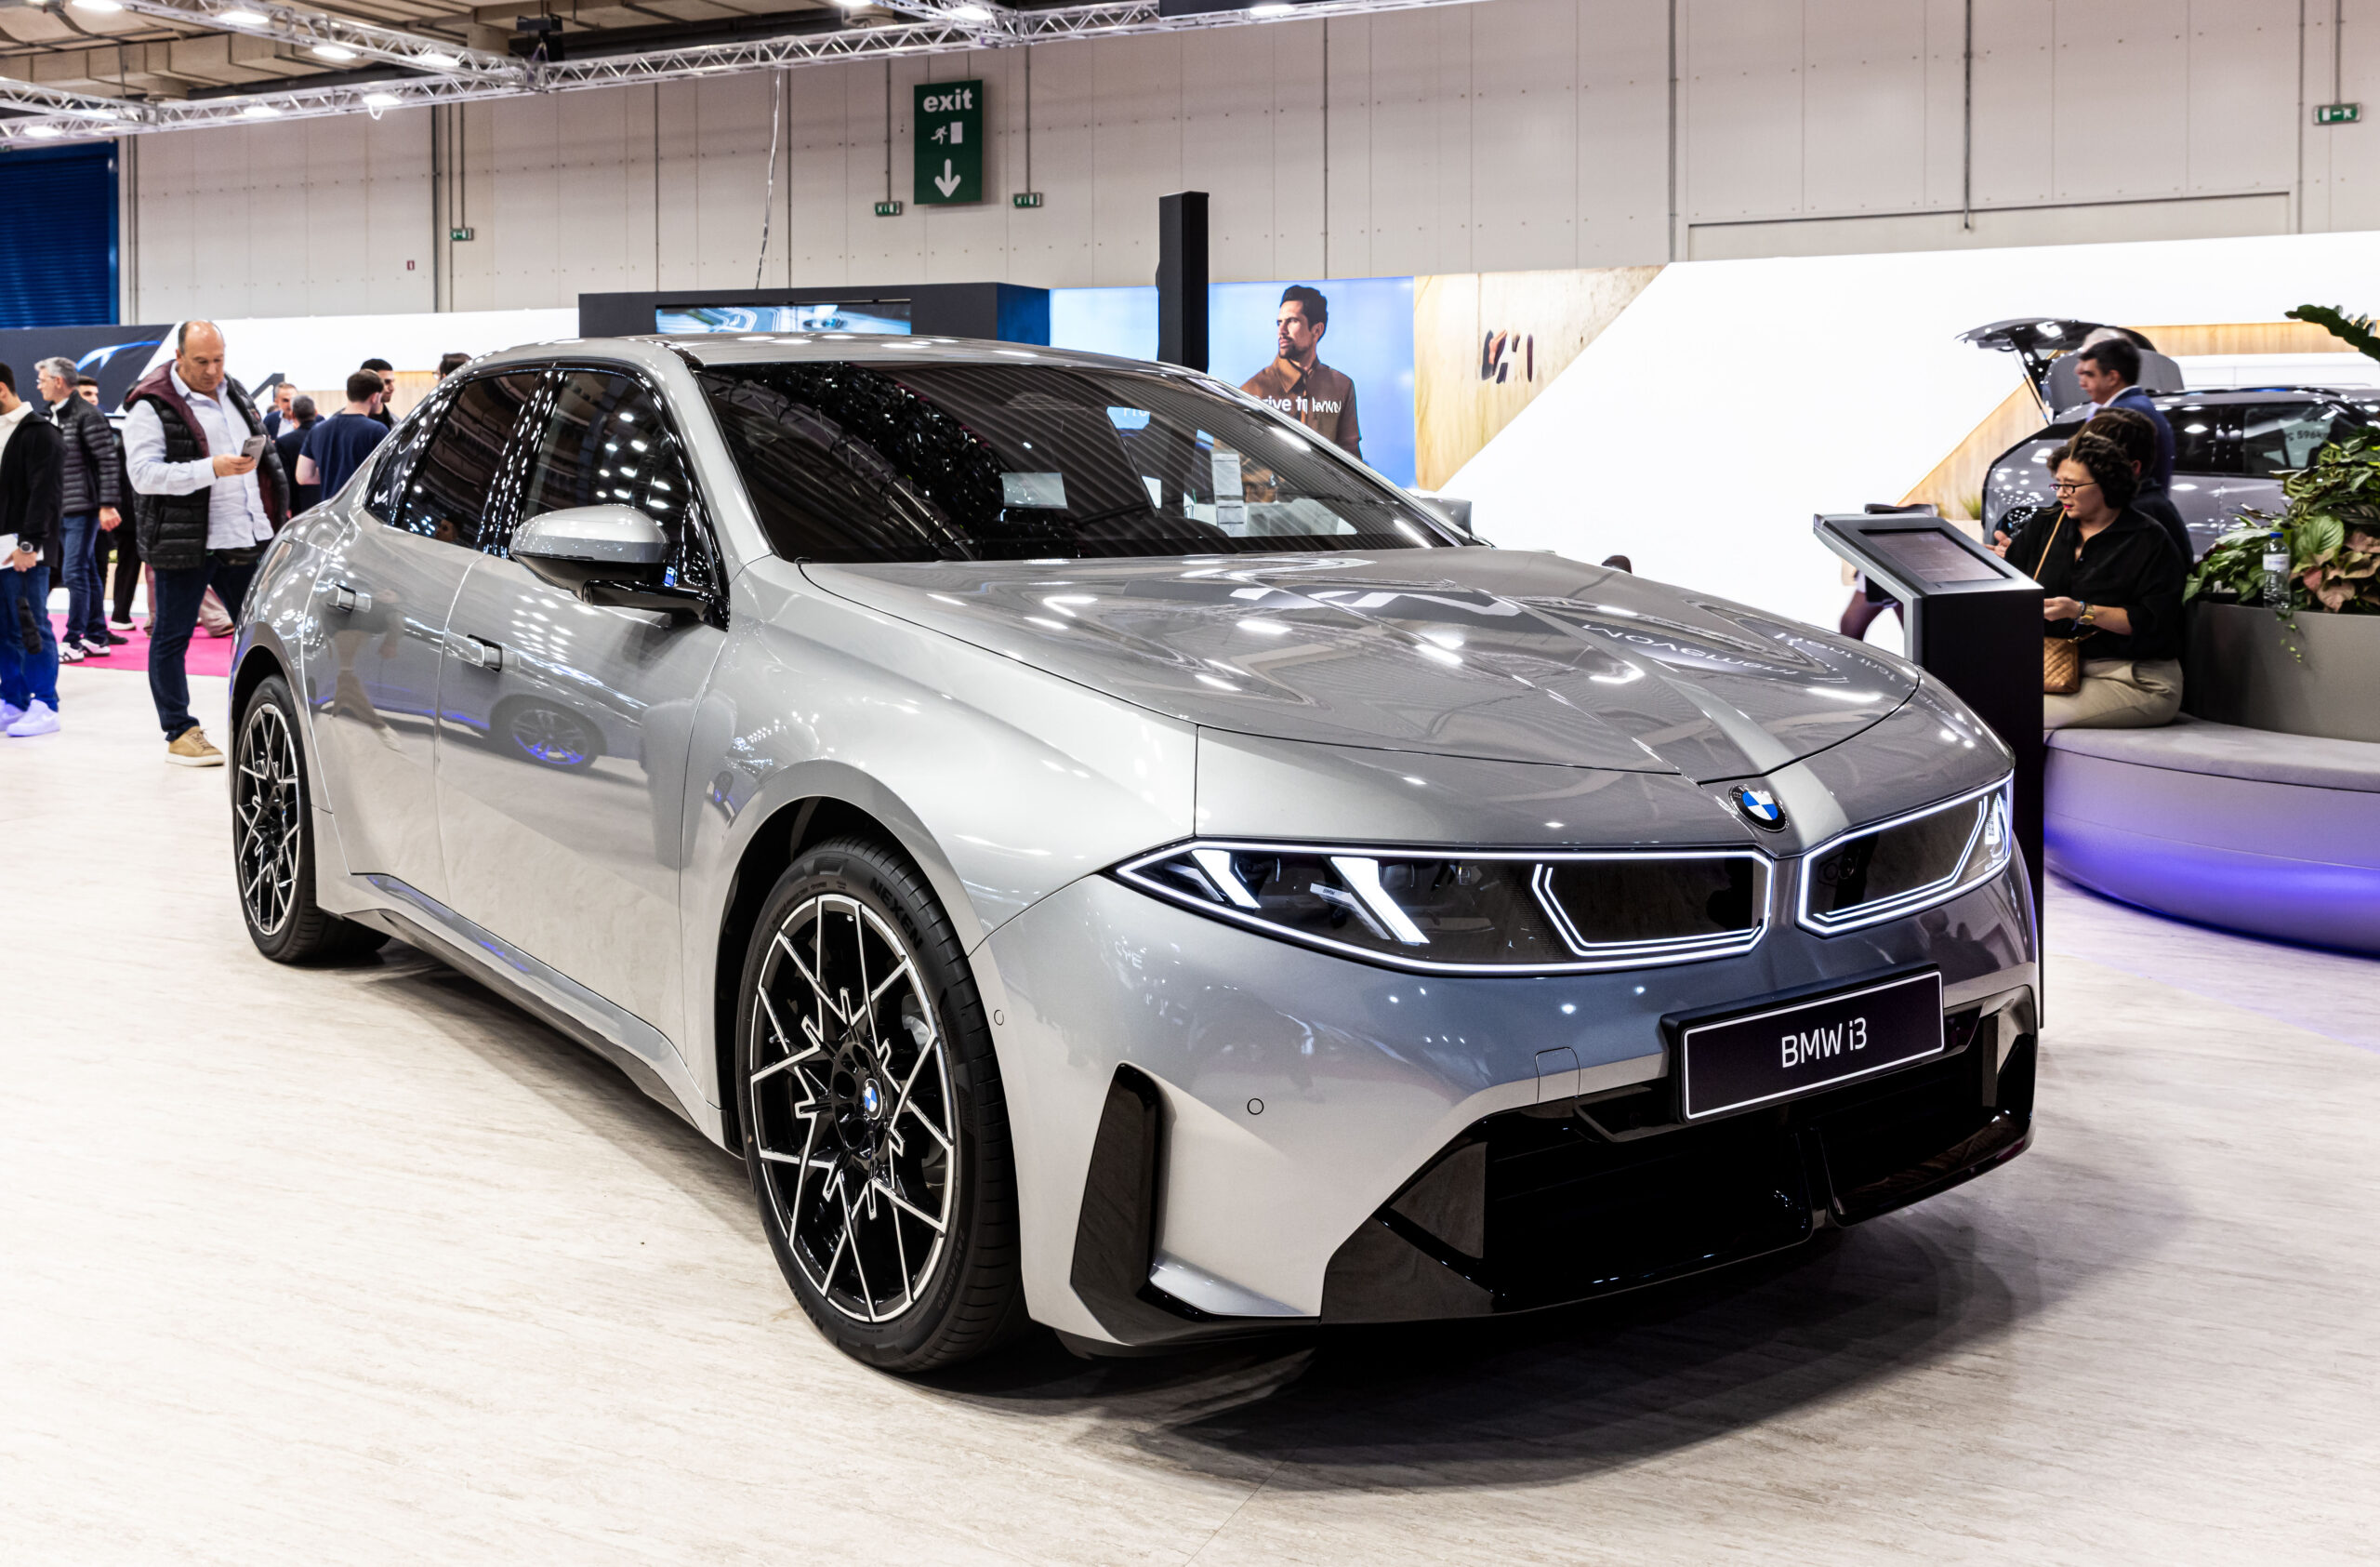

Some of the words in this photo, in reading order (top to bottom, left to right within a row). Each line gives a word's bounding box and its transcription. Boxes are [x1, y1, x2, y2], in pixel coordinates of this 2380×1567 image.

[923, 88, 972, 113] exit
[869, 877, 923, 950] NEXEN
[1781, 1023, 1843, 1069] BMW
[1848, 1016, 1868, 1052] i3
